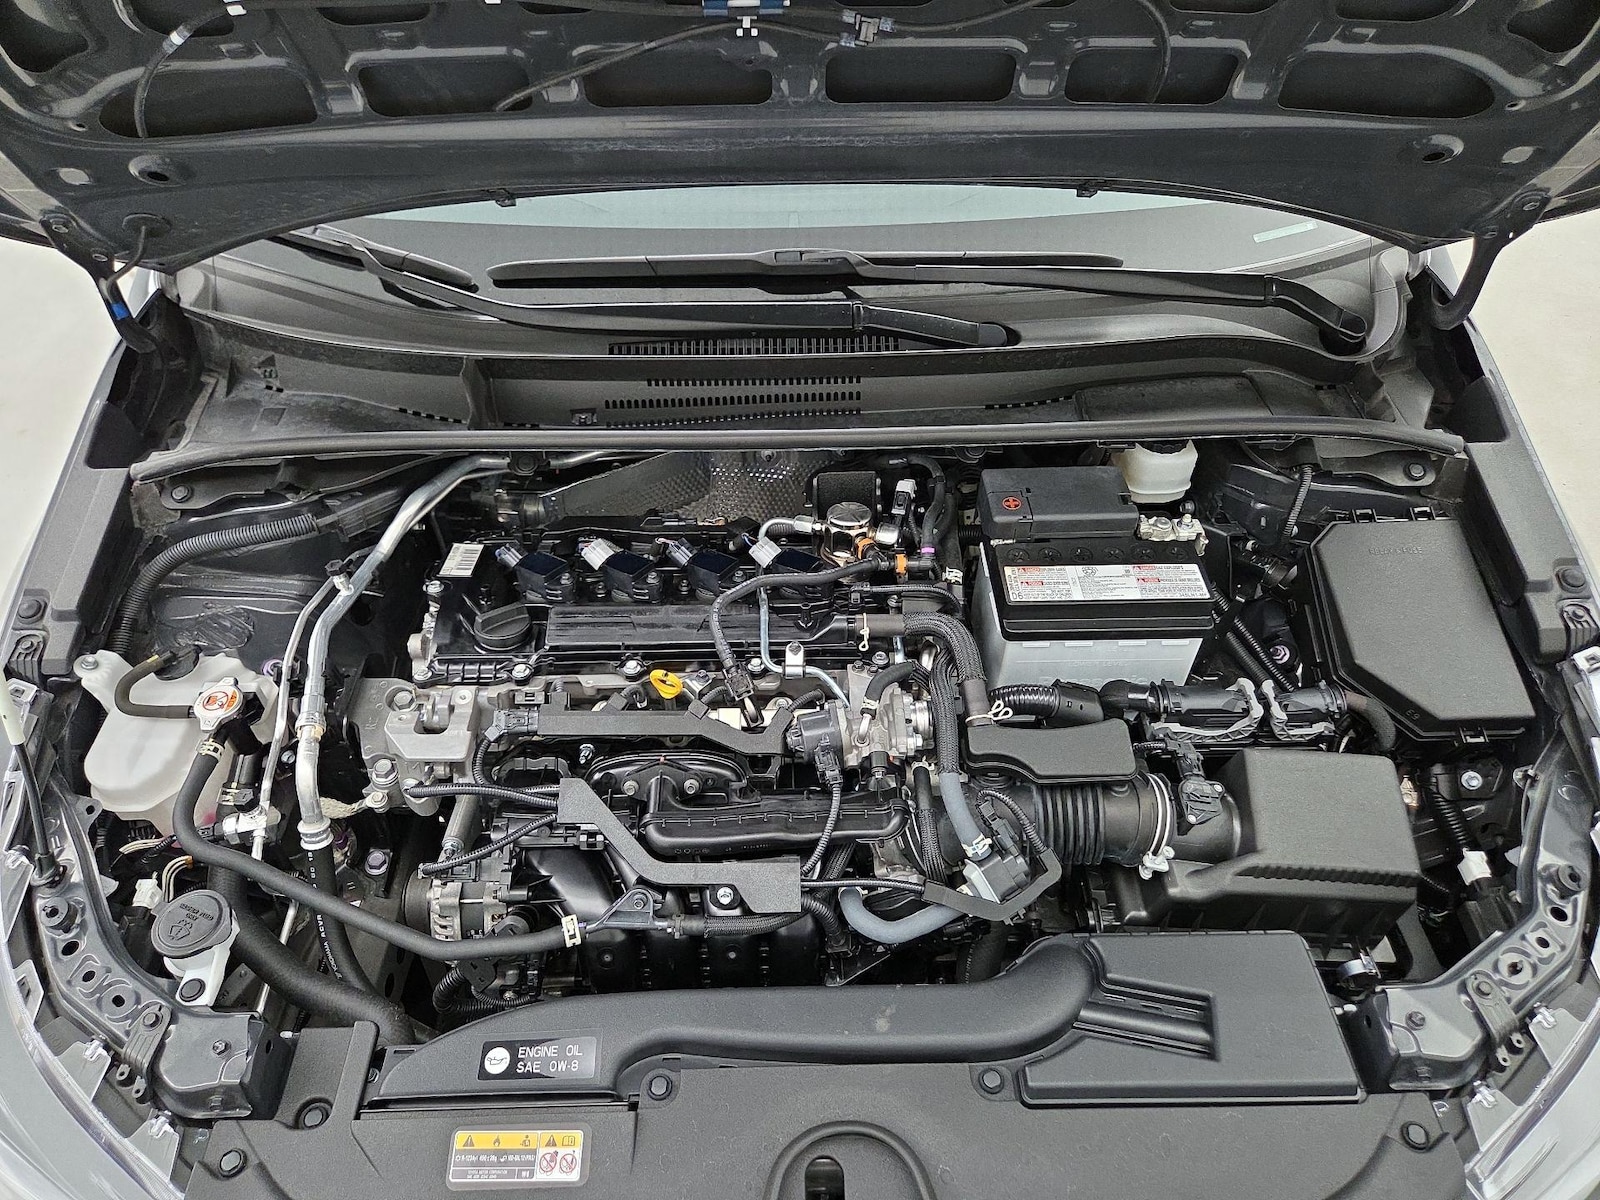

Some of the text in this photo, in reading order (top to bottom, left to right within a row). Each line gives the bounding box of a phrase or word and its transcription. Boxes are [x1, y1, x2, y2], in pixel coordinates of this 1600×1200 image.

[517, 1044, 583, 1058] ENGINE OIL
[516, 1061, 541, 1074] SAE
